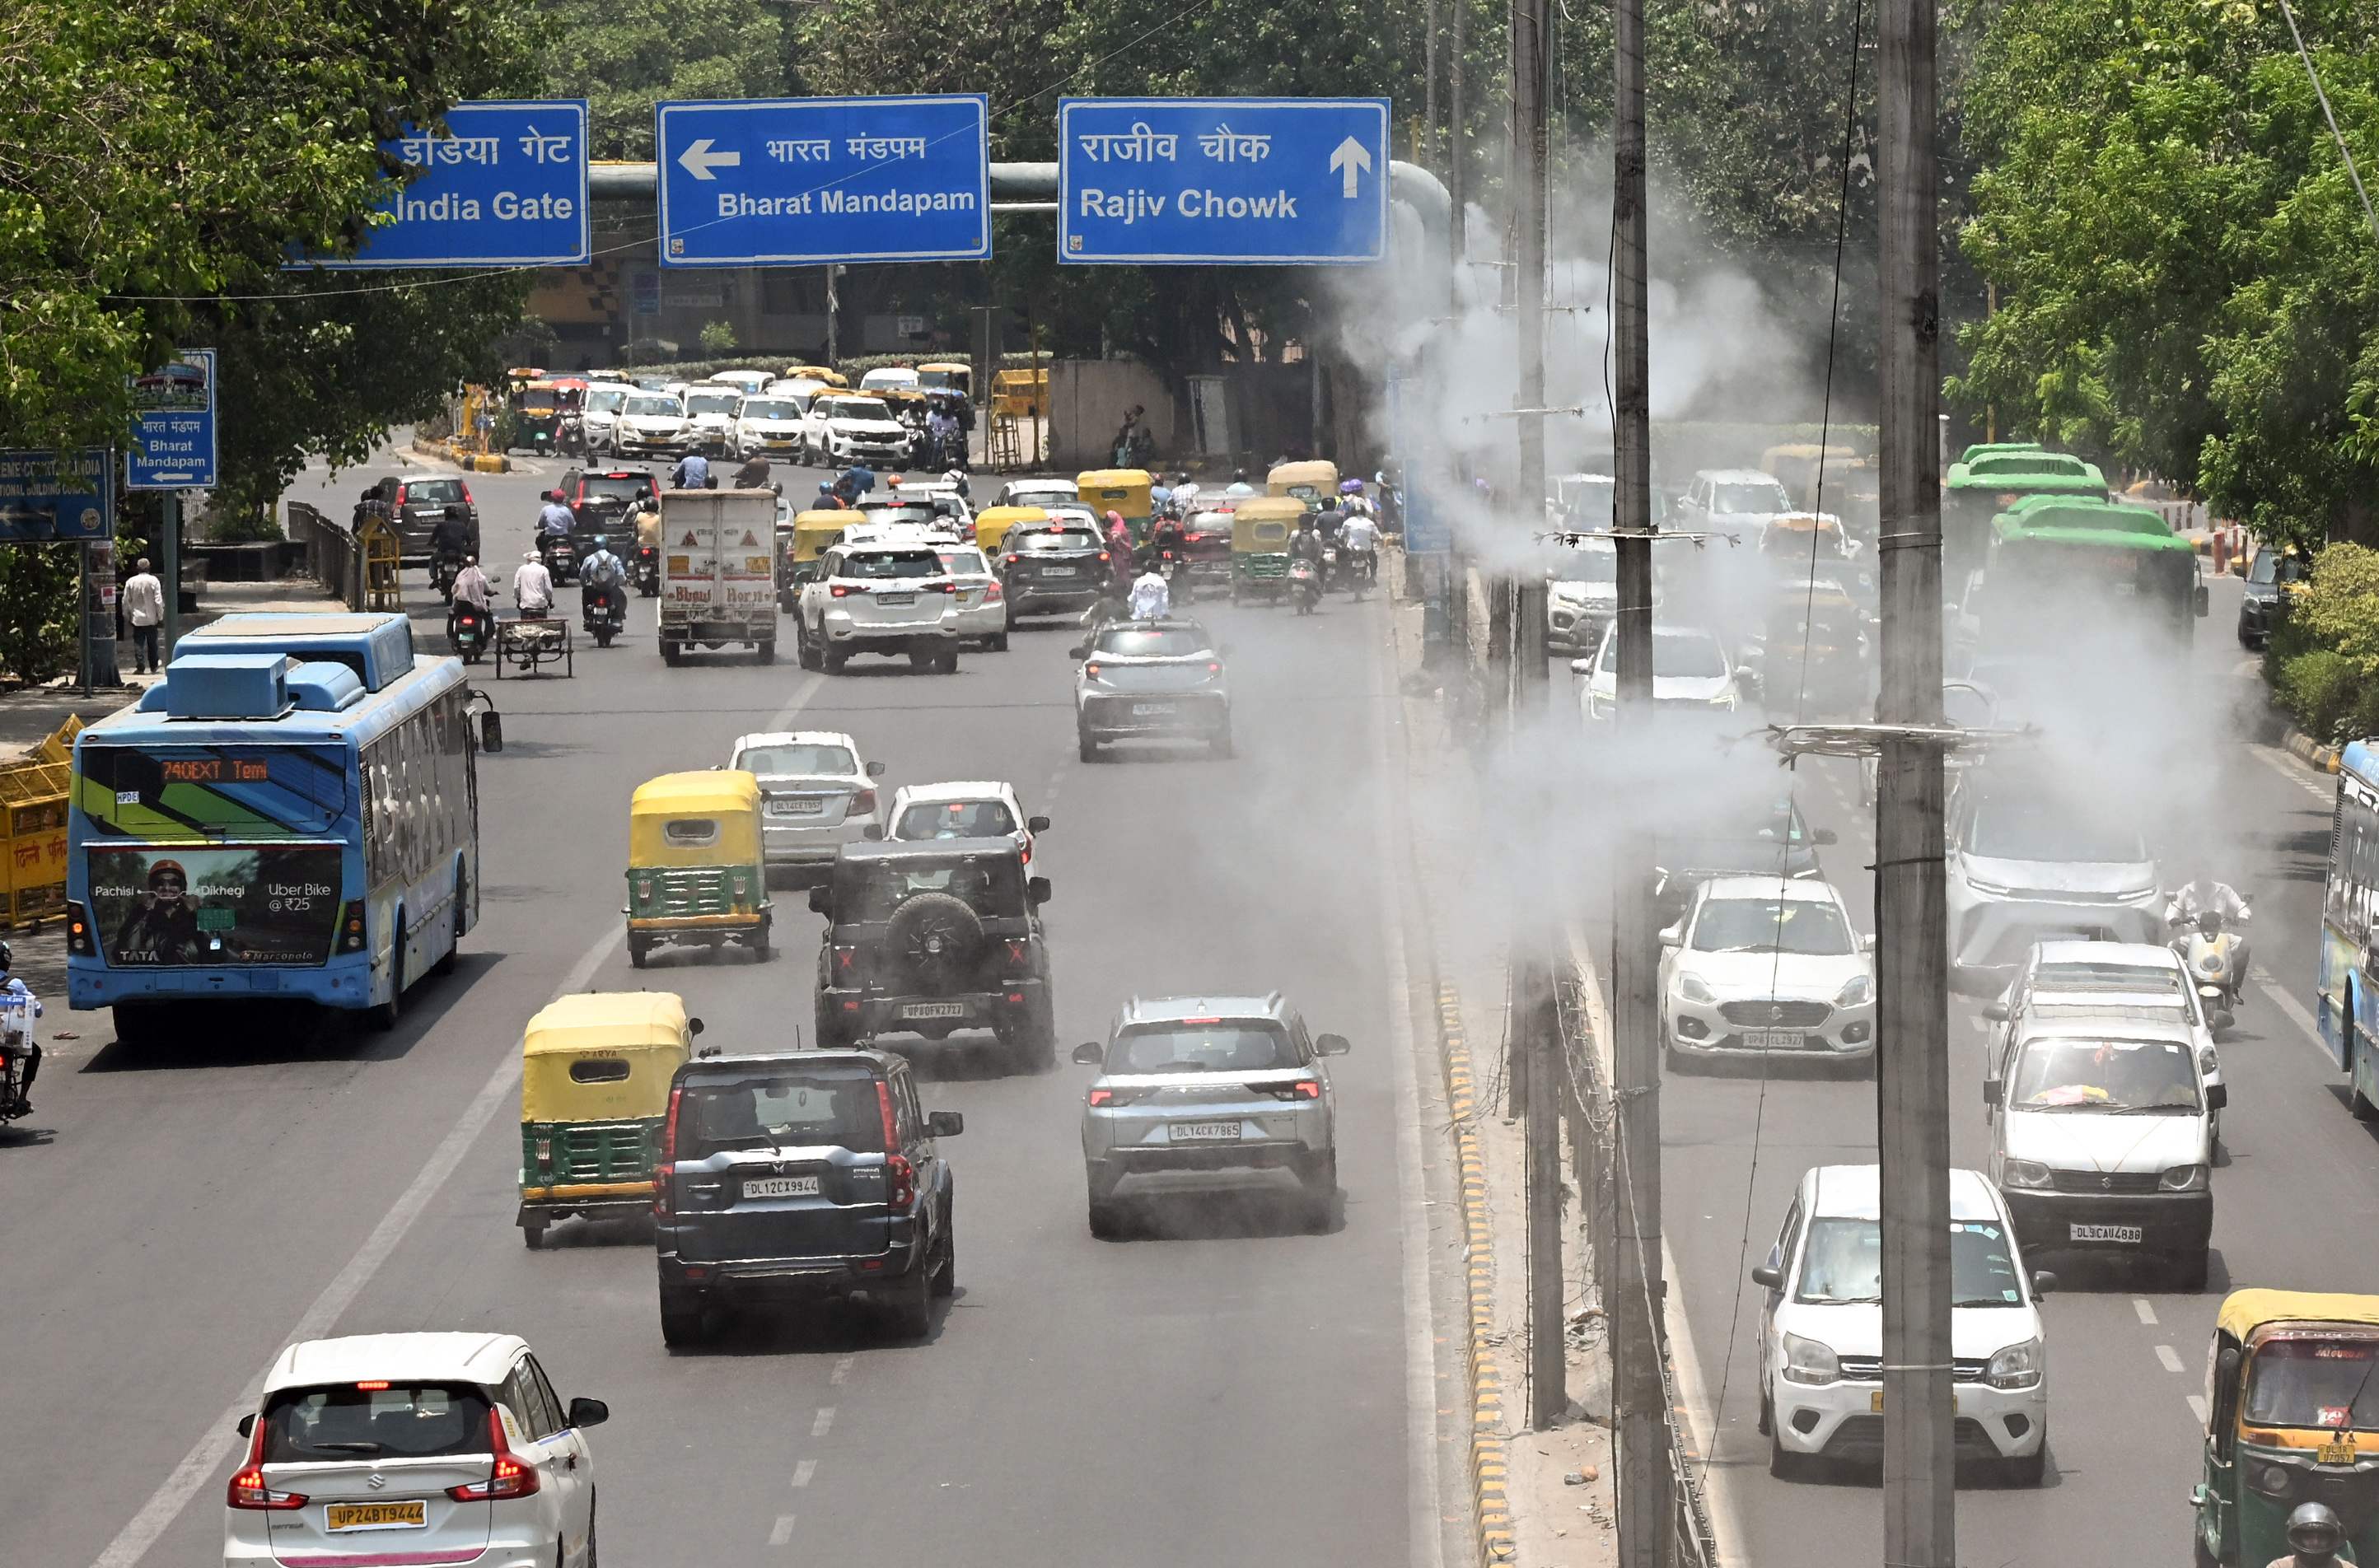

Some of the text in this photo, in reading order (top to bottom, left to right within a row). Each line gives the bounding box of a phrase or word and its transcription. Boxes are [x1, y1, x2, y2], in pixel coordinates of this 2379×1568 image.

[519, 125, 572, 163] गेट
[766, 132, 926, 162] भारत मंडपम
[1078, 122, 1271, 162] राजीव चौक
[397, 191, 573, 221] India Gate
[718, 189, 975, 217] Bharat Mandapam
[1081, 189, 1297, 224] Rajiv Chowk
[142, 417, 200, 433] भारत मंडपम
[150, 440, 193, 452] Bharat
[137, 455, 206, 469] Mandapam
[95, 885, 245, 898] Pachisi Dikhegi
[269, 883, 331, 896] Uber Bike
[119, 950, 313, 962] TATA Marcopolo
[338, 1506, 423, 1524] UP24BT9444
